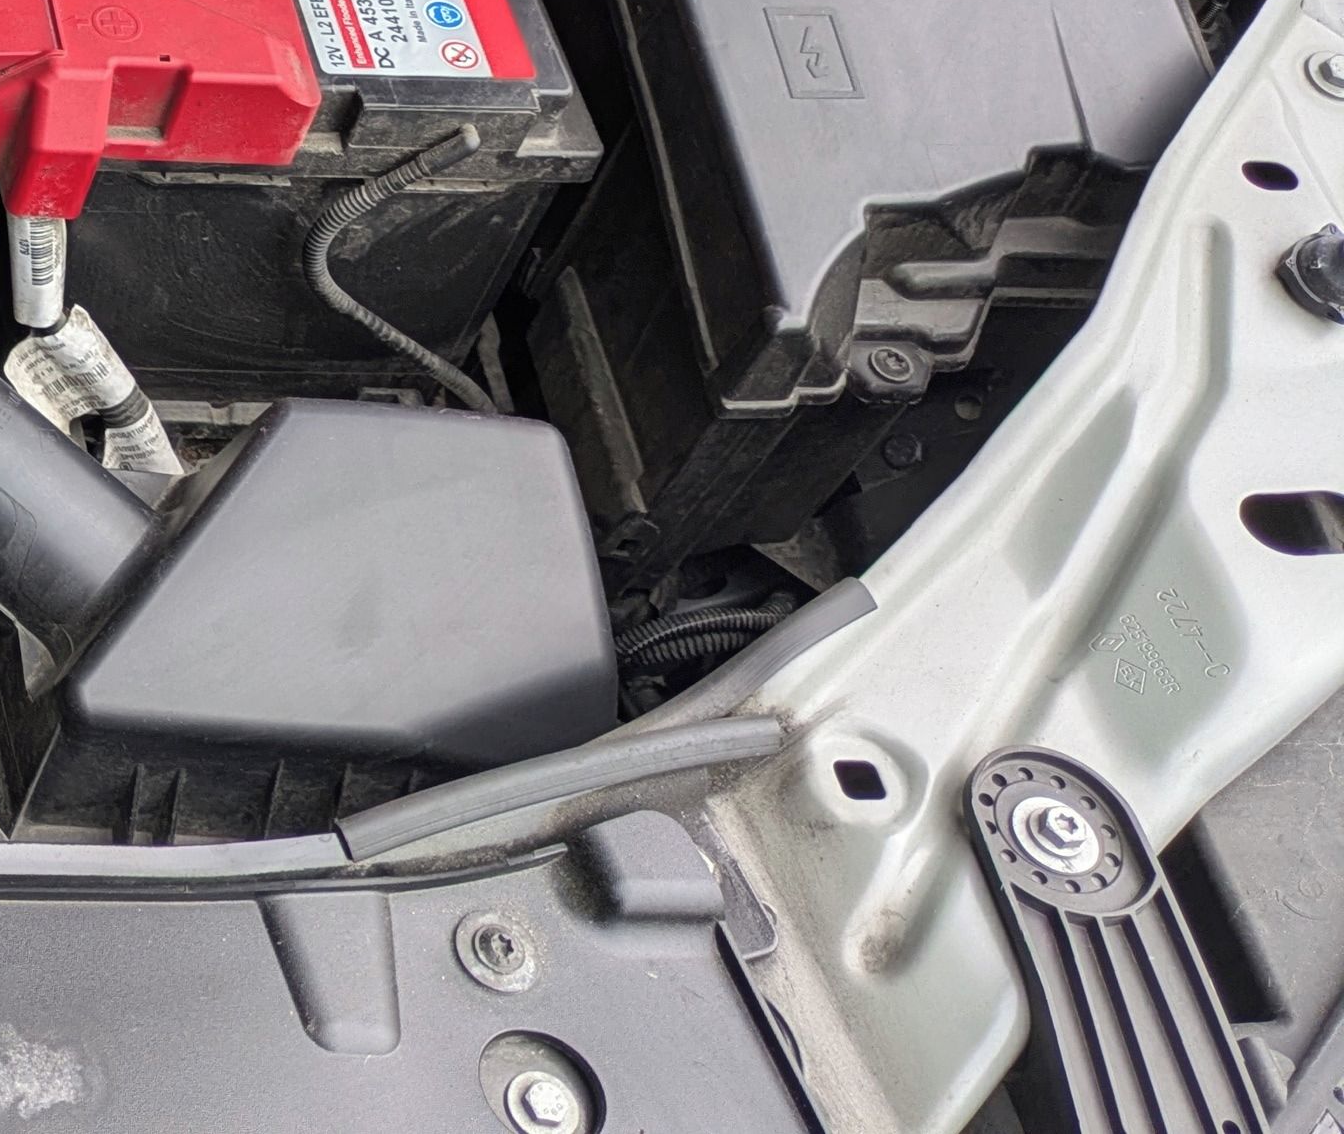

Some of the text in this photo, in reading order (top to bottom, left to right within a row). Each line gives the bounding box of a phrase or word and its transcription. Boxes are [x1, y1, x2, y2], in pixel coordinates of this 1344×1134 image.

[408, 10, 418, 19] in
[317, 21, 335, 36] L2
[368, 30, 386, 42] A
[412, 19, 428, 43] Made
[324, 45, 346, 67] 12V
[345, 26, 368, 65] Enhanced
[373, 46, 396, 69] DC
